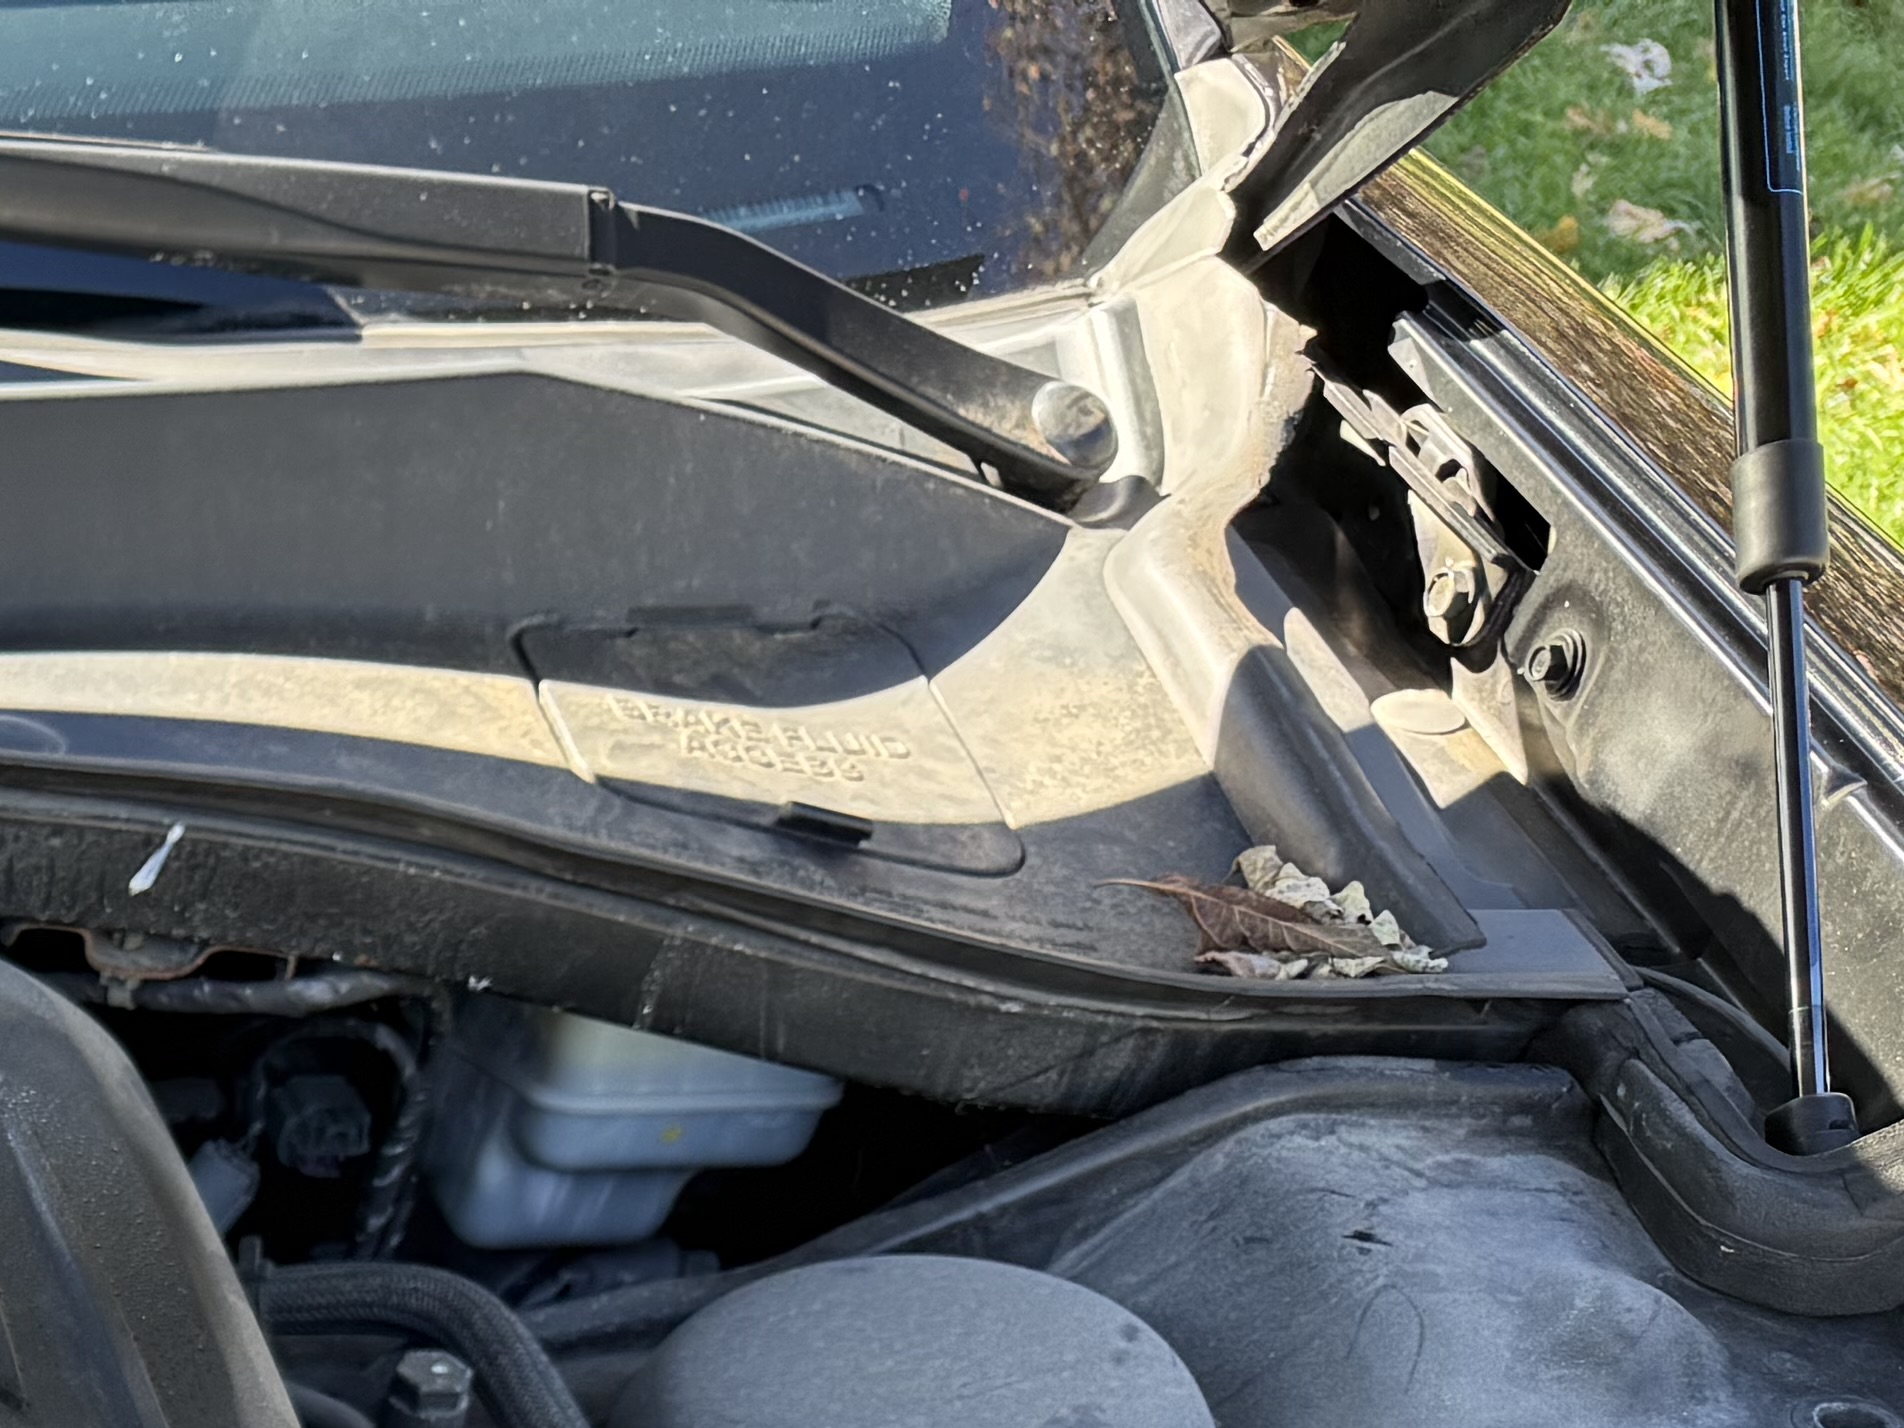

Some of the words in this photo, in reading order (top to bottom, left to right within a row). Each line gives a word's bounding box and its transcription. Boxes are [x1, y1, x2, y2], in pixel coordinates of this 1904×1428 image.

[605, 694, 770, 743] BRAKE
[772, 722, 910, 759] FLUID
[677, 731, 864, 782] ACCESS
